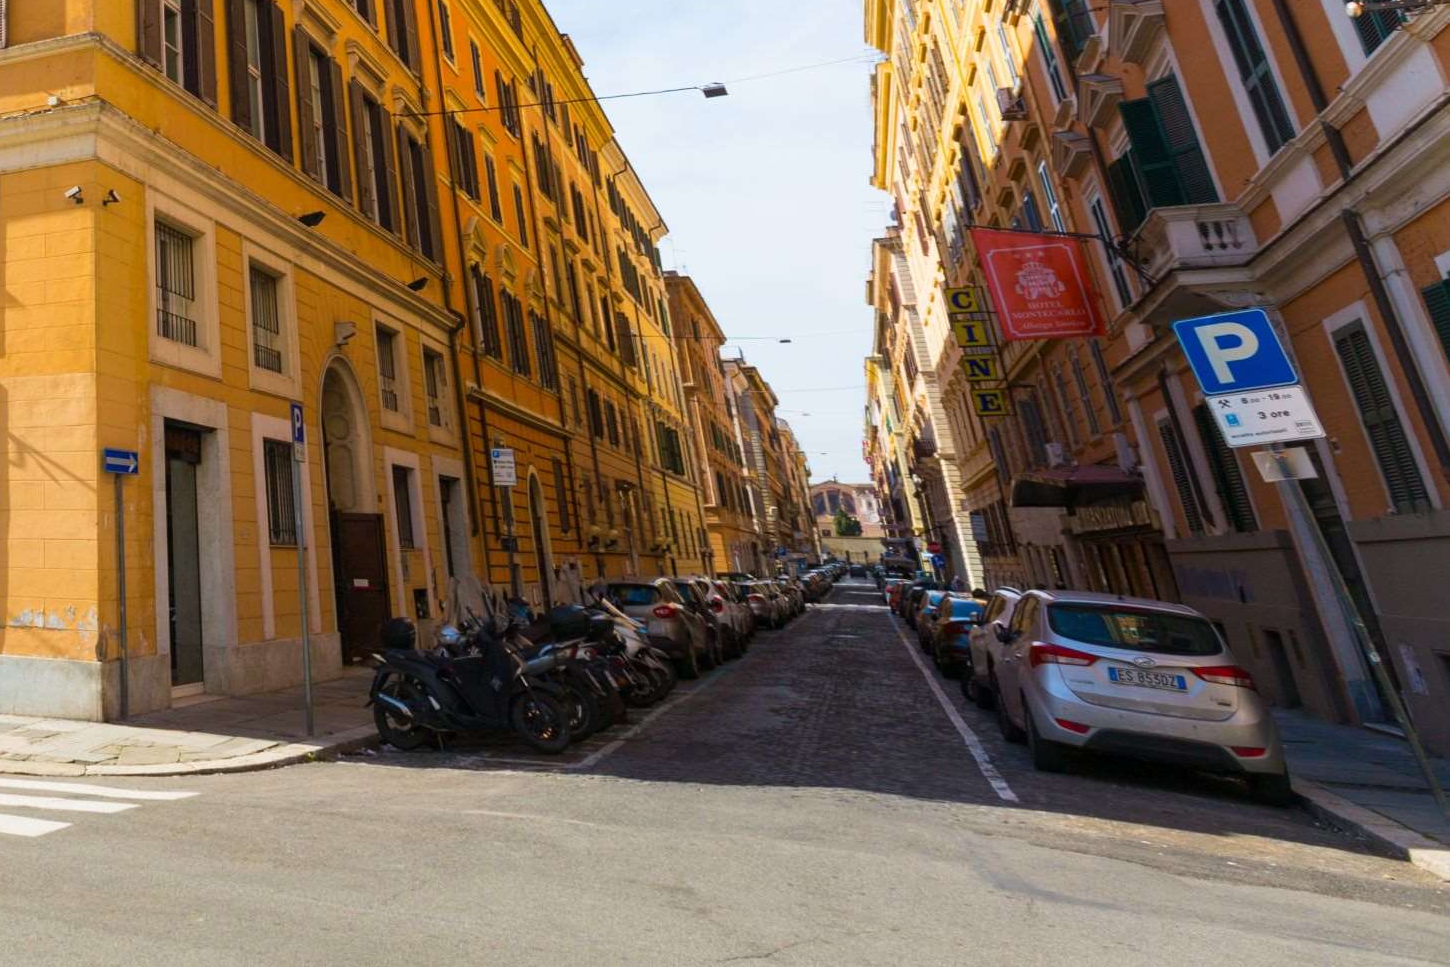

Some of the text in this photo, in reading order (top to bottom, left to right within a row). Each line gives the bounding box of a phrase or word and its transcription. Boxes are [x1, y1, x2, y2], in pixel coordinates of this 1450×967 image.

[951, 291, 1001, 412] CINE
[1194, 322, 1259, 384] P
[293, 407, 302, 438] P
[1258, 409, 1290, 420] 3 ore
[1118, 669, 1133, 682] ES
